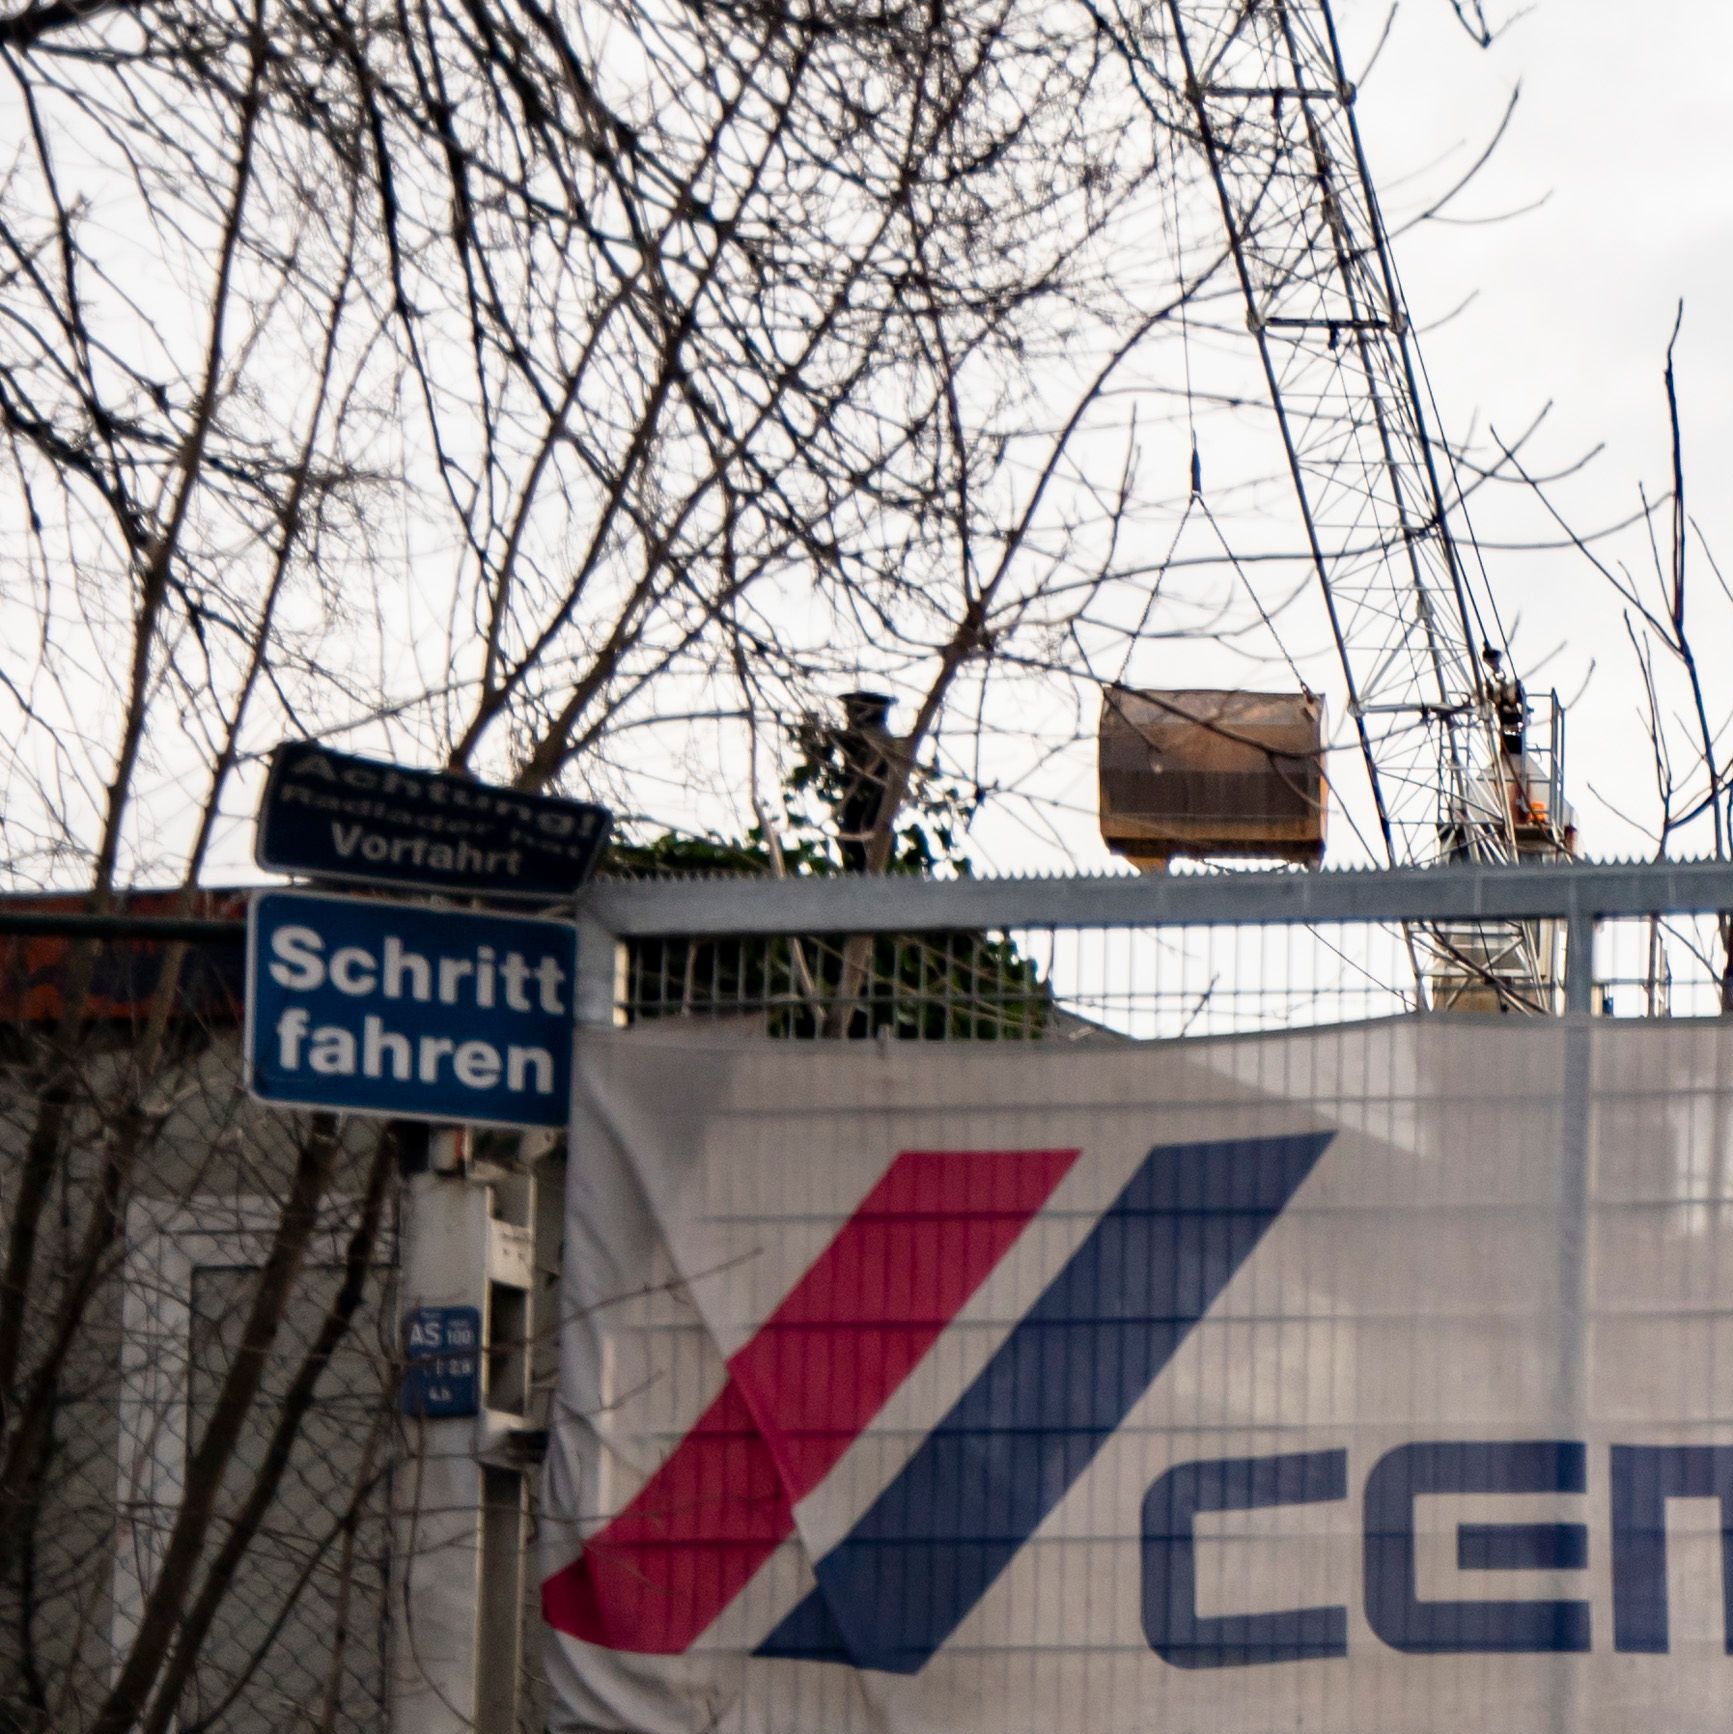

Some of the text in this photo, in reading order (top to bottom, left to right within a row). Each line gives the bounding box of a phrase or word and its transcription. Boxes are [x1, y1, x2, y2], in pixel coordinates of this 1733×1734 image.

[291, 753, 598, 839] Achtung!
[331, 820, 524, 877] Vorfahrt
[269, 924, 566, 1015] Schritt
[275, 1007, 555, 1095] fahren
